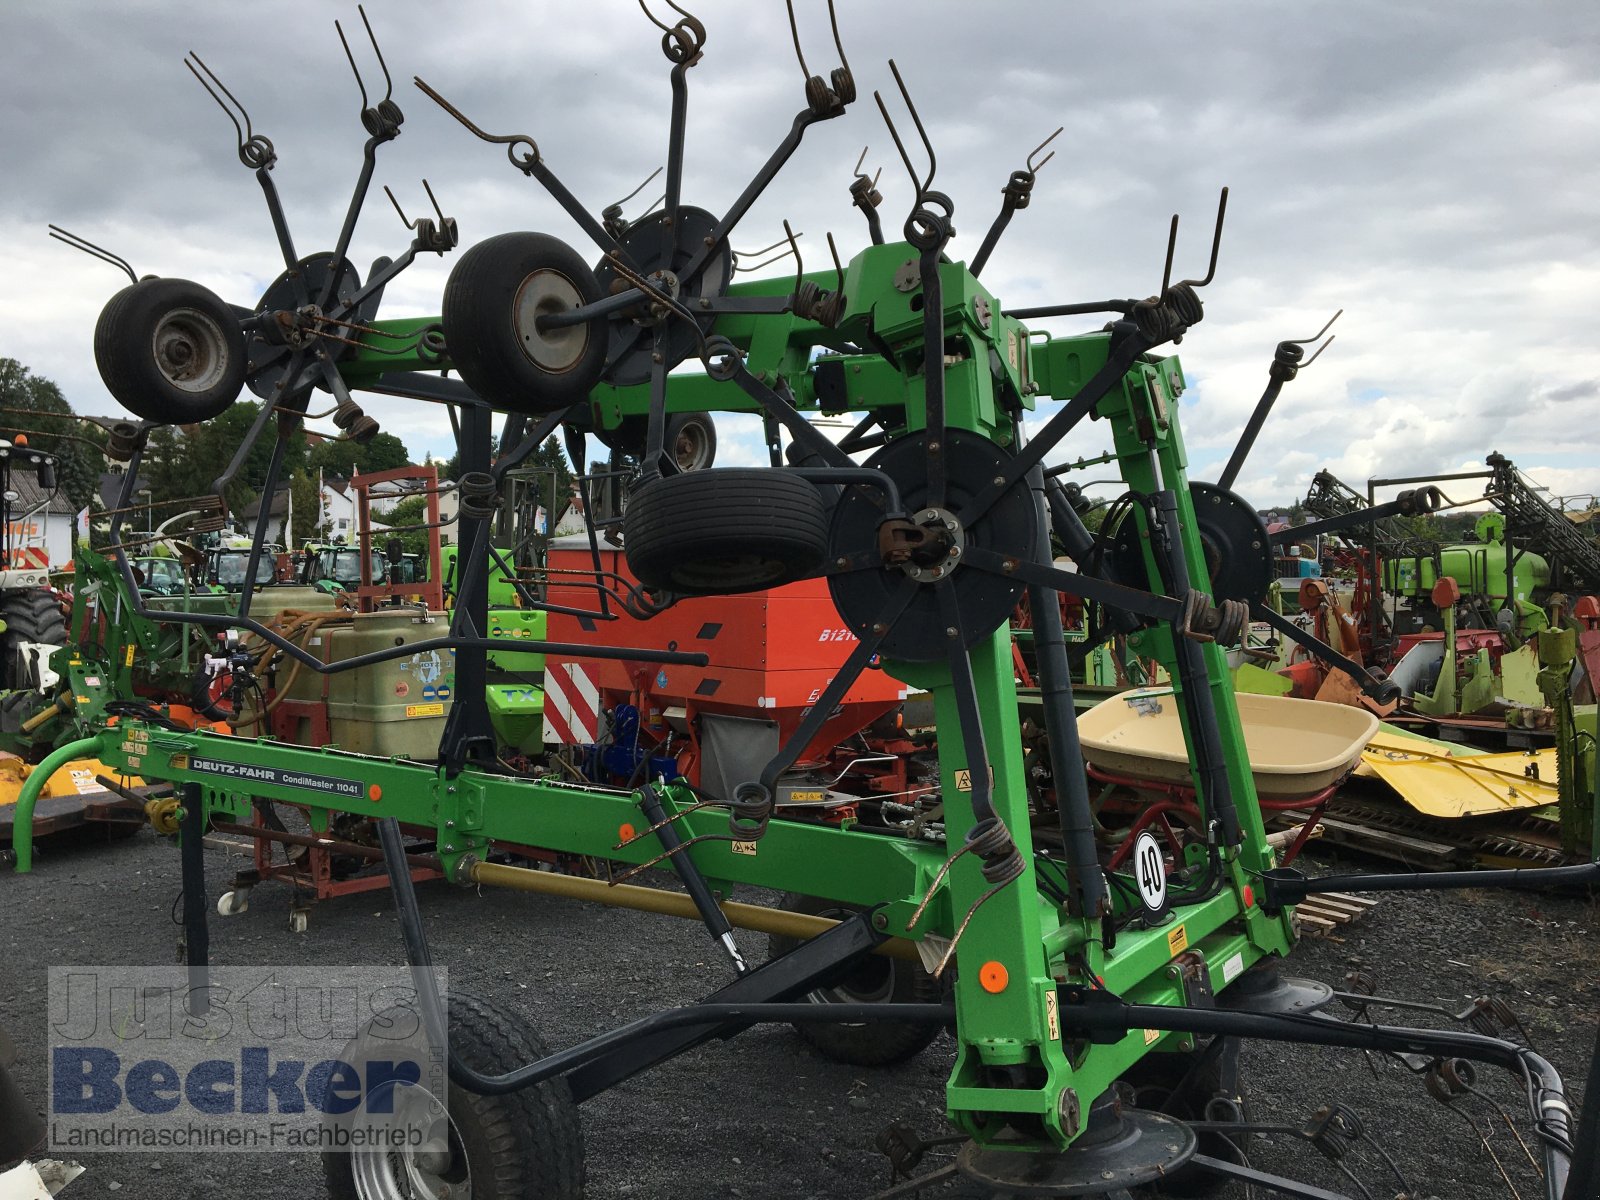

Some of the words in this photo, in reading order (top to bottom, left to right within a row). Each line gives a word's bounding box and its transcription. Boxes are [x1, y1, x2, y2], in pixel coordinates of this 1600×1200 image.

[501, 689, 536, 702] TX
[193, 759, 275, 780] DEUTZ-FAHR
[282, 774, 333, 790] CondiMaster
[336, 782, 358, 794] 11041
[1141, 845, 1162, 897] 40
